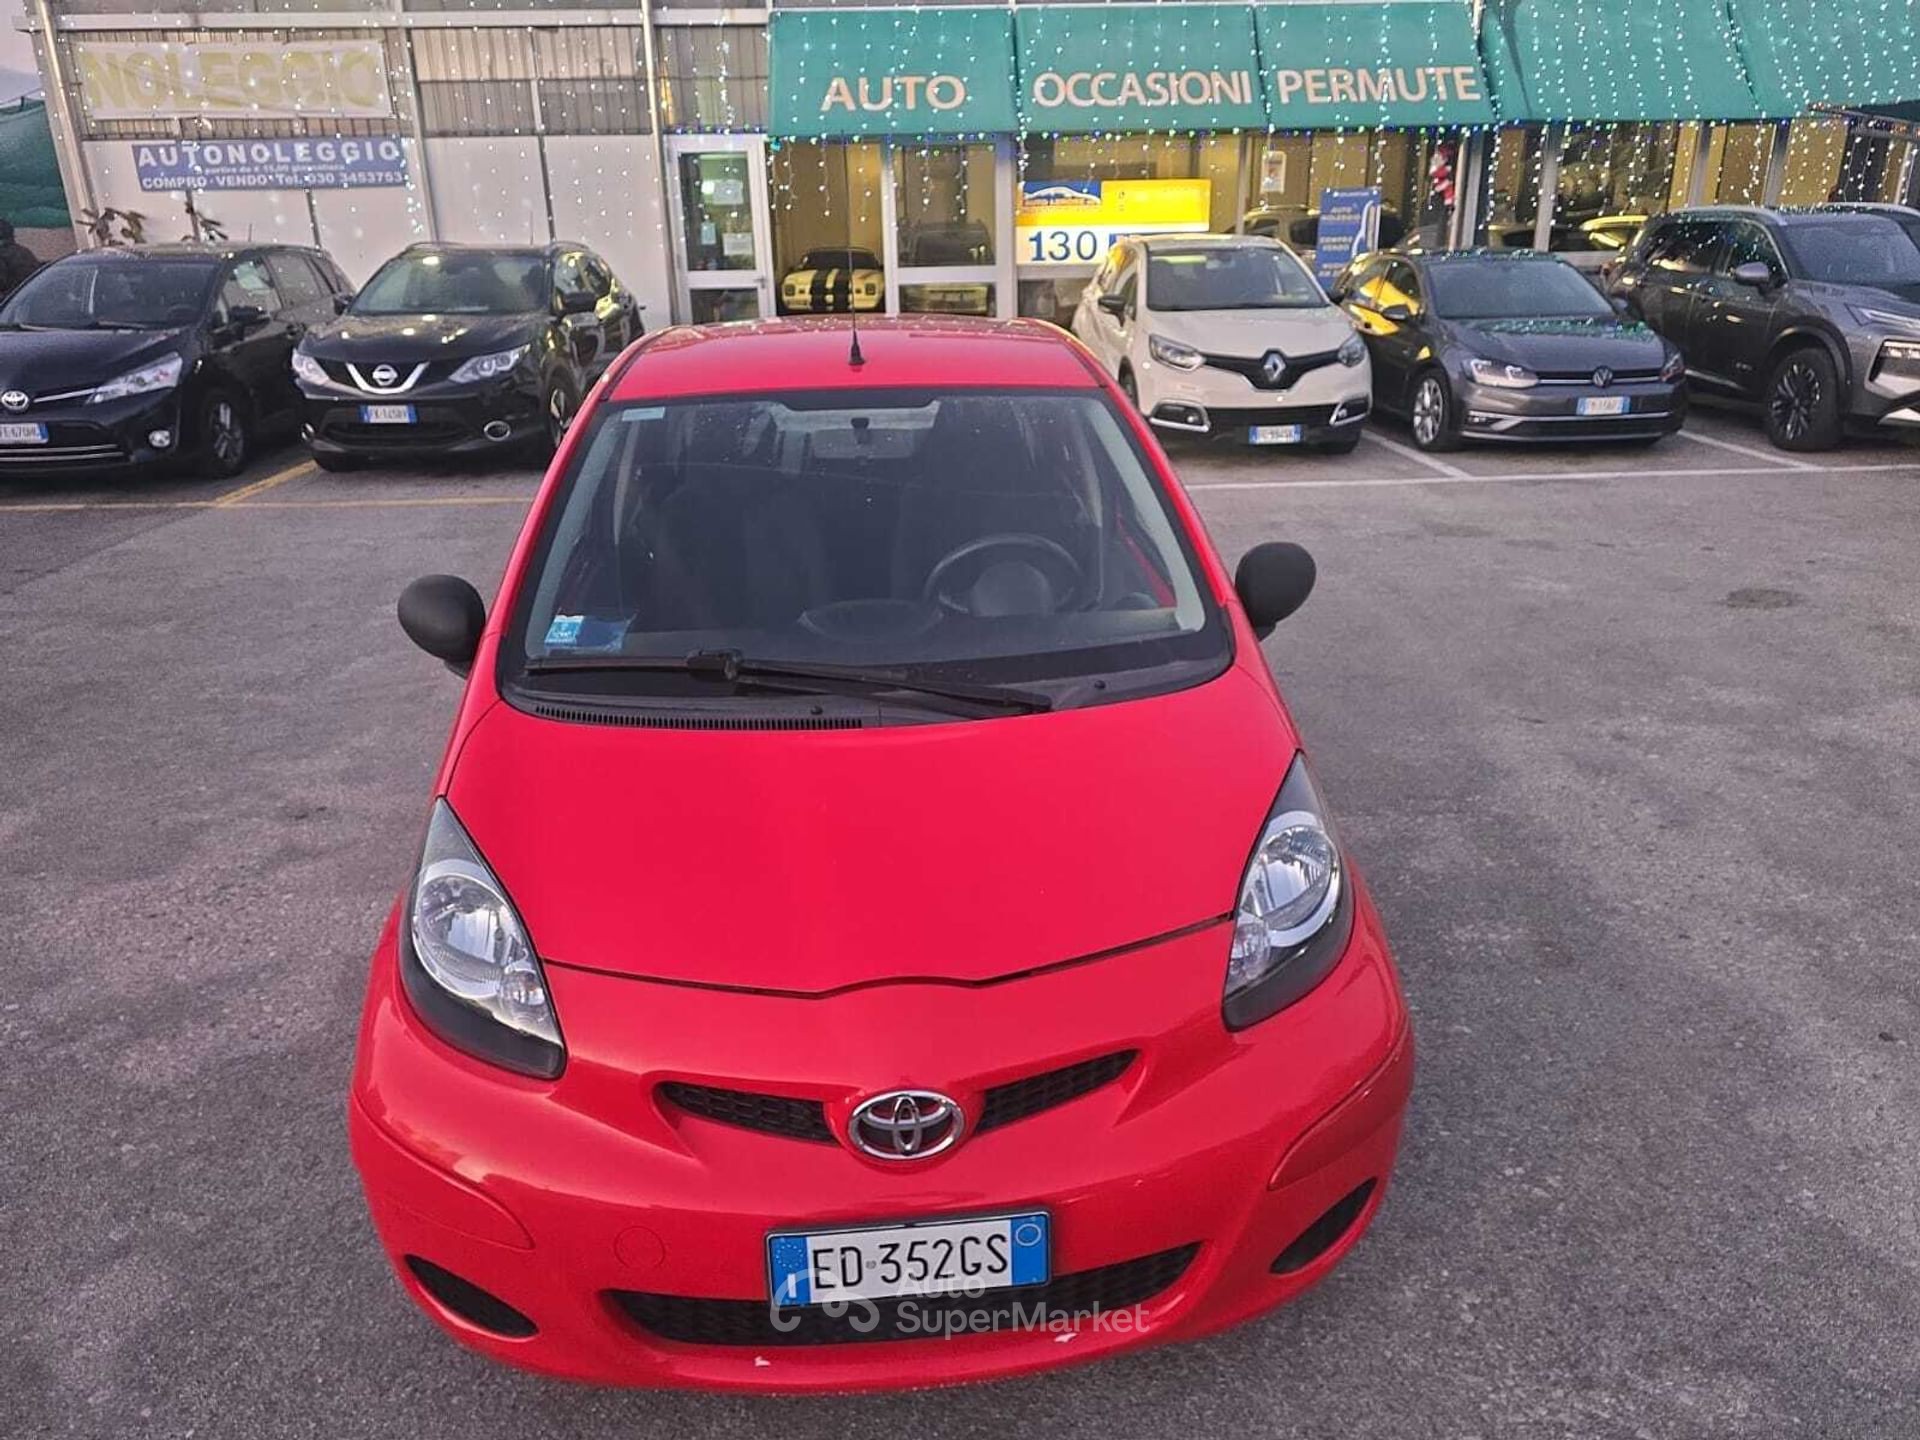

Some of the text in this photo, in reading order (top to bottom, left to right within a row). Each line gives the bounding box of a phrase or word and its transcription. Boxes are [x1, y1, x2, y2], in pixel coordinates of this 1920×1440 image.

[80, 51, 379, 108] NOLEGGIO
[820, 74, 967, 111] AUTO
[1033, 71, 1253, 108] OCCASIONI
[1276, 66, 1482, 104] PERMUTE
[138, 141, 400, 167] AUTONOLEGGIO
[142, 176, 207, 189] COMPRO
[216, 173, 268, 187] VENDO
[1028, 230, 1098, 261] 130
